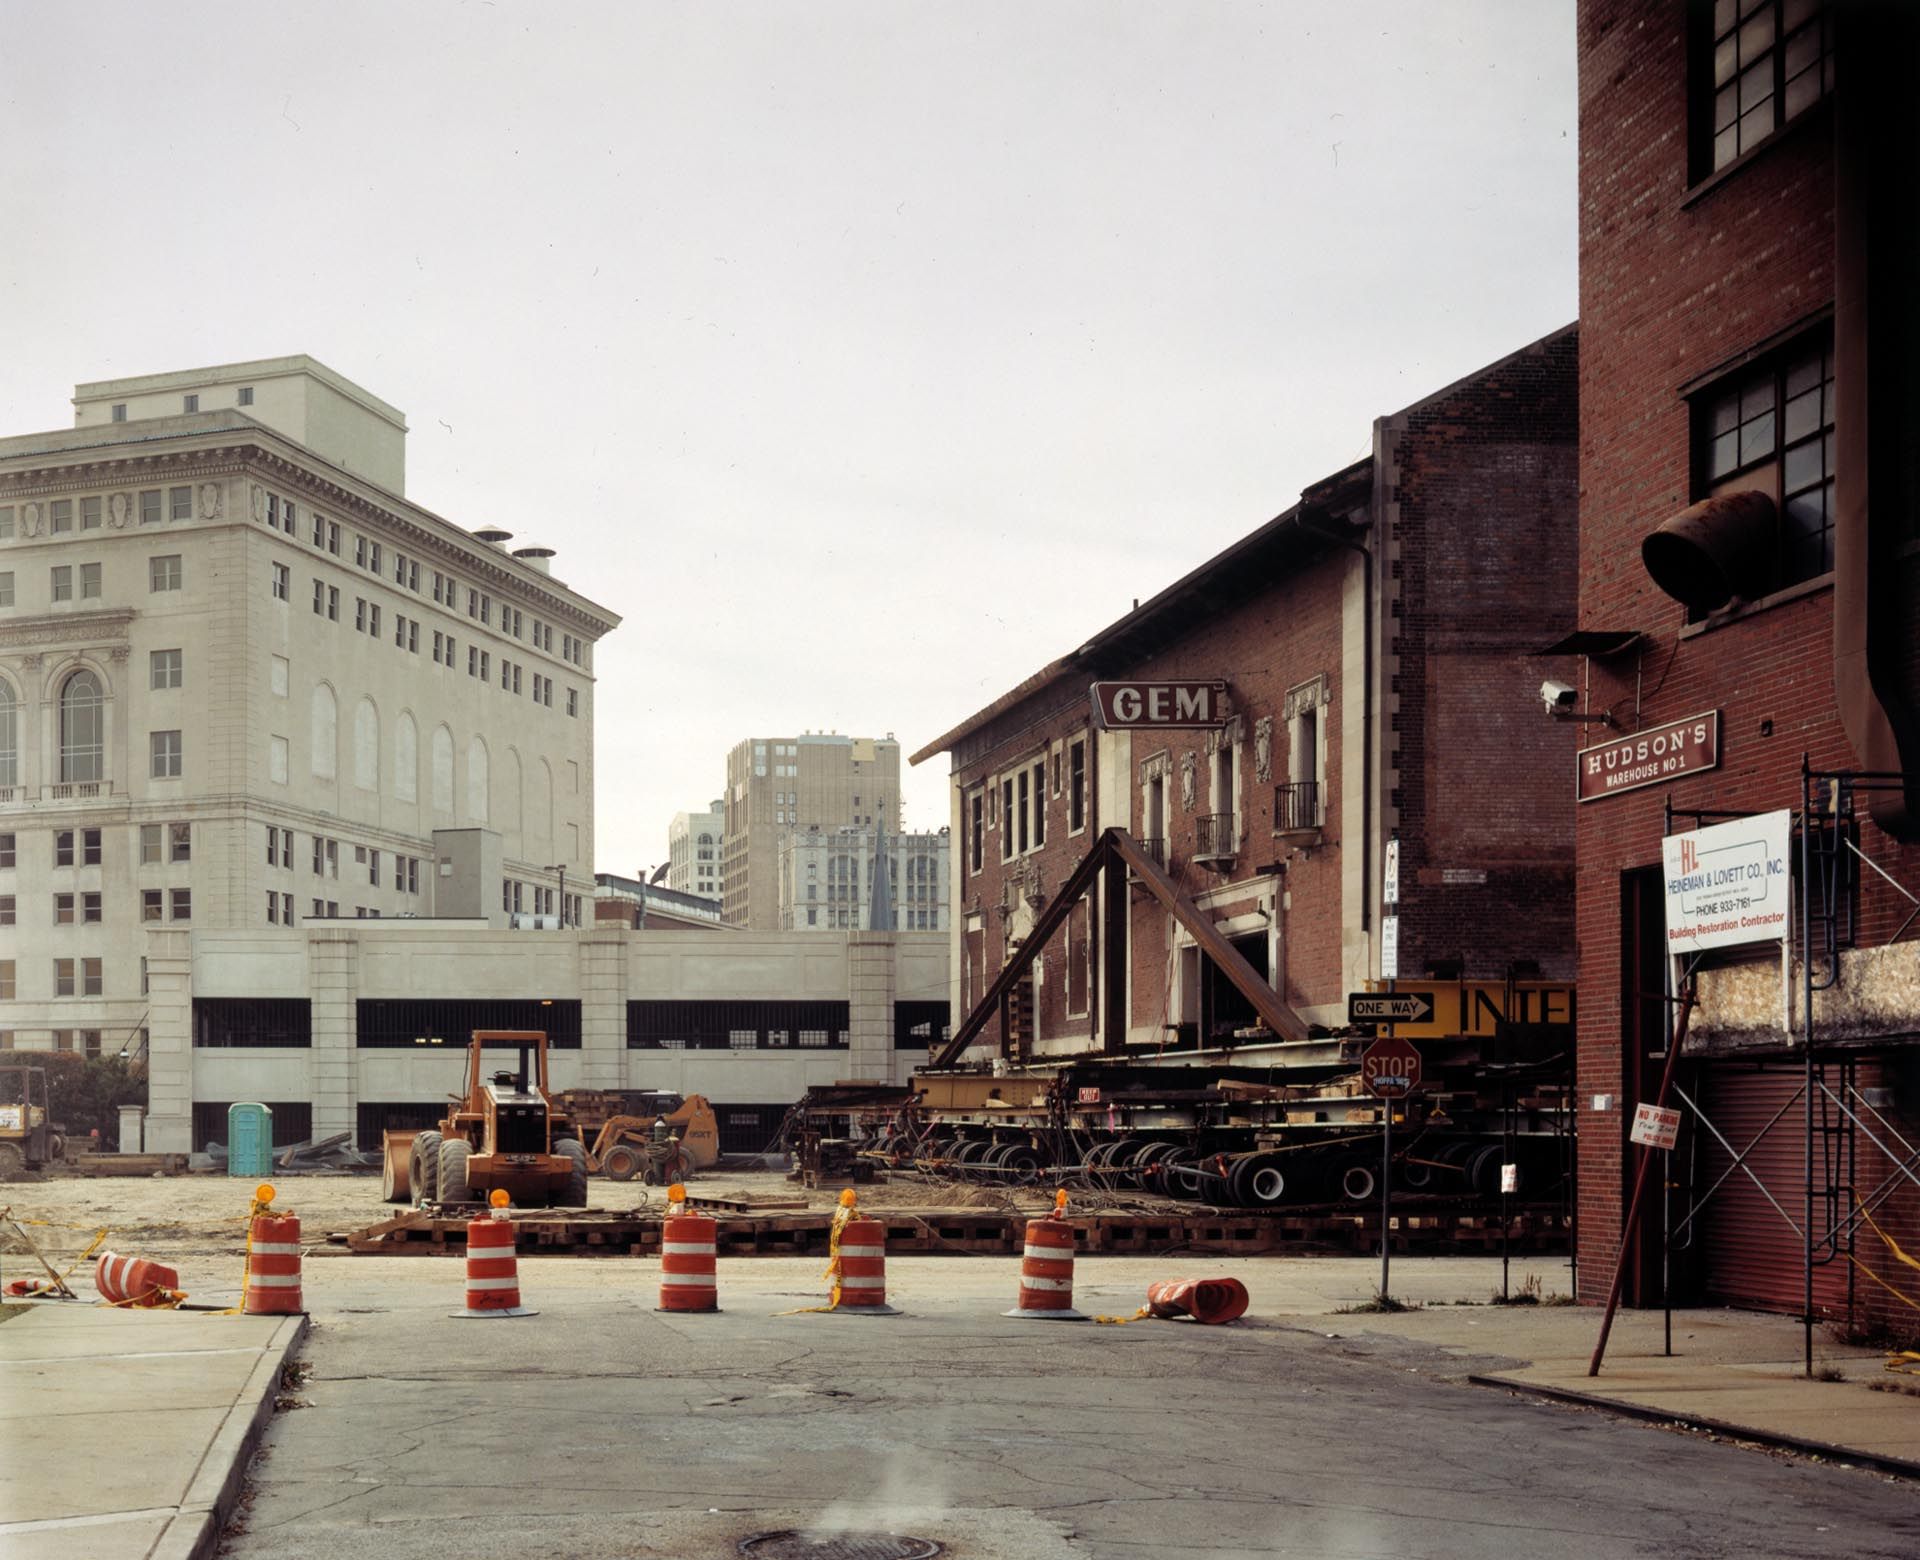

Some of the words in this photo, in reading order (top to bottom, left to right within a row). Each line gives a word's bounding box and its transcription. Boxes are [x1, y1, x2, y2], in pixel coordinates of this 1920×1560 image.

[1113, 687, 1209, 722] GEM
[1588, 724, 1706, 774] HUDSON'S
[1607, 763, 1658, 787] WAREHOUSE
[1663, 759, 1676, 773] NO
[1679, 755, 1686, 768] 1
[1668, 874, 1704, 895] HEINEMAN
[1706, 873, 1712, 887] &
[1714, 866, 1745, 885] LOVETT
[1696, 903, 1718, 916] PHONE
[1669, 926, 1696, 940] Building
[1698, 920, 1738, 935] Restoration
[1741, 912, 1784, 928] Contractor
[1355, 1002, 1383, 1014] ONE
[1391, 1002, 1419, 1014] WAY
[1366, 1056, 1417, 1078] STOP
[1638, 1110, 1649, 1120] NO
